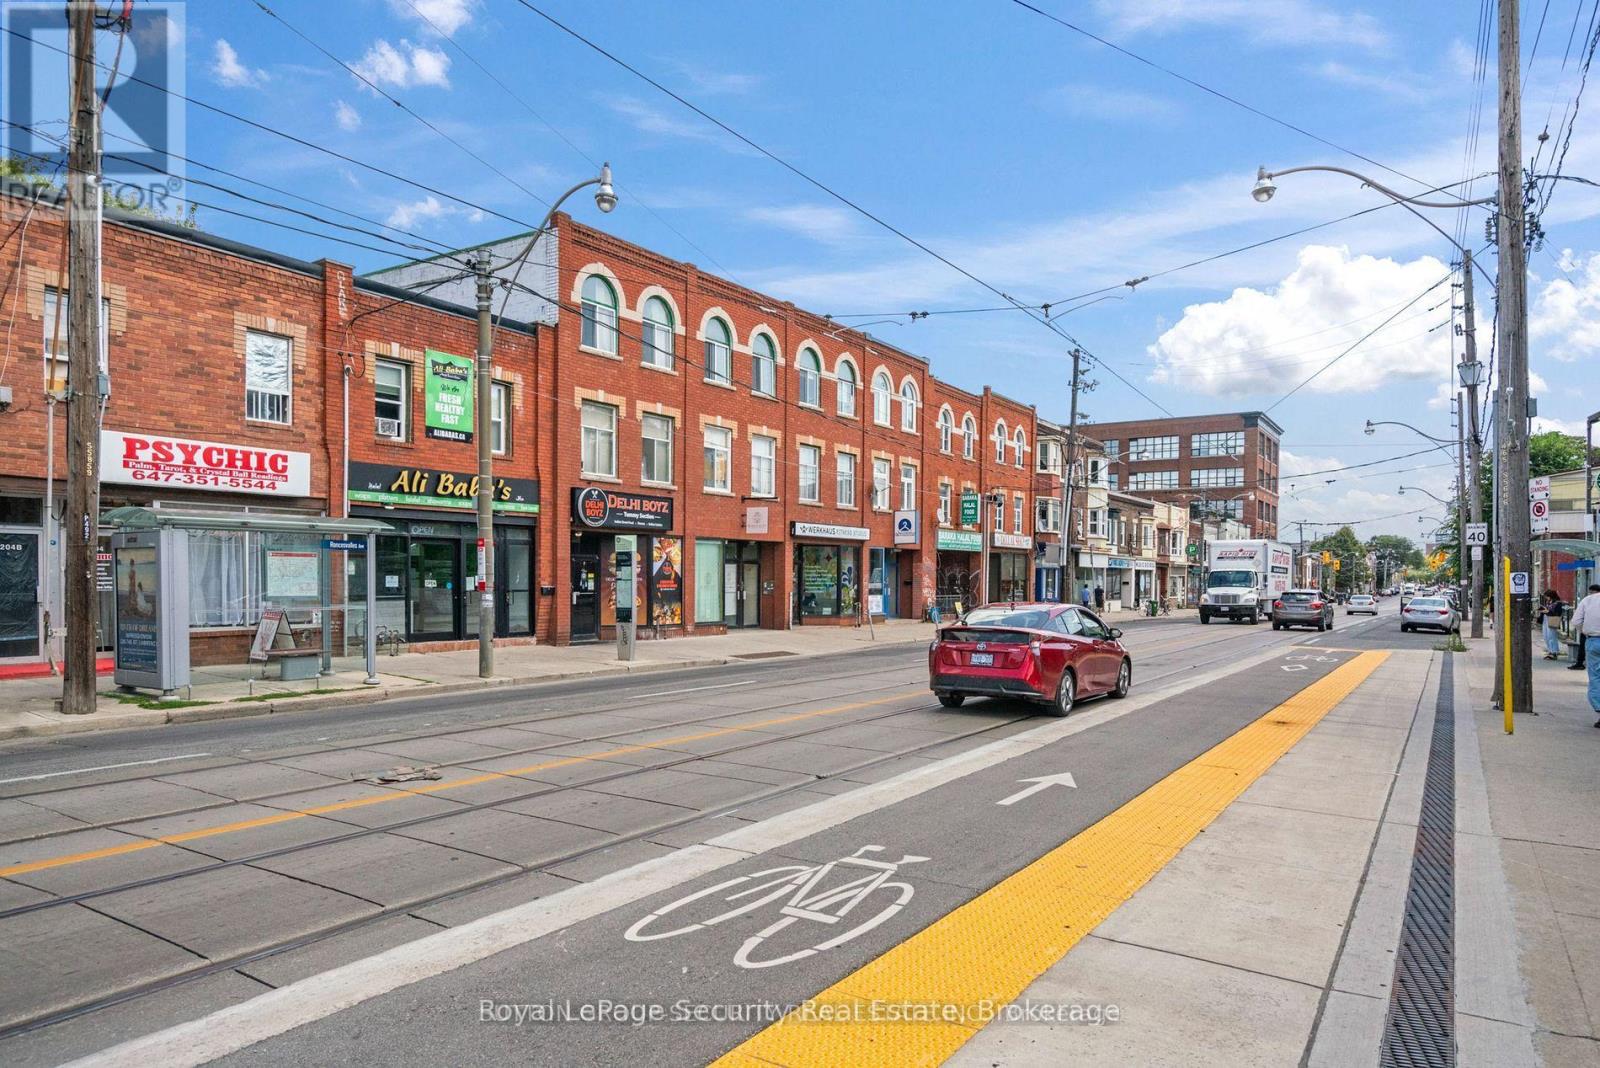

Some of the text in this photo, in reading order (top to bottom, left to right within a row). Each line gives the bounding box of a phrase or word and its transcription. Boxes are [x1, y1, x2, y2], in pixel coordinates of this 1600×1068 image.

[433, 365, 444, 373] Ali
[439, 392, 461, 405] FRESH
[434, 401, 464, 416] HEALTHY
[441, 413, 459, 425] FAST
[433, 428, 466, 440] ALIBABAS.CA
[122, 437, 289, 474] PSYCHIC
[128, 461, 287, 483] Palm, Tarot, & Crystal Ball Readings
[132, 470, 278, 491] 647-351-5544
[391, 470, 512, 500] Ali Bab's
[1530, 485, 1549, 494] STANDING
[585, 500, 604, 509] DELHI
[608, 494, 669, 513] DELHI BOYZ
[586, 508, 604, 517] BOYZ
[411, 526, 434, 535] OPEN
[808, 526, 836, 536] WERKHAUS
[1467, 531, 1486, 542] 40
